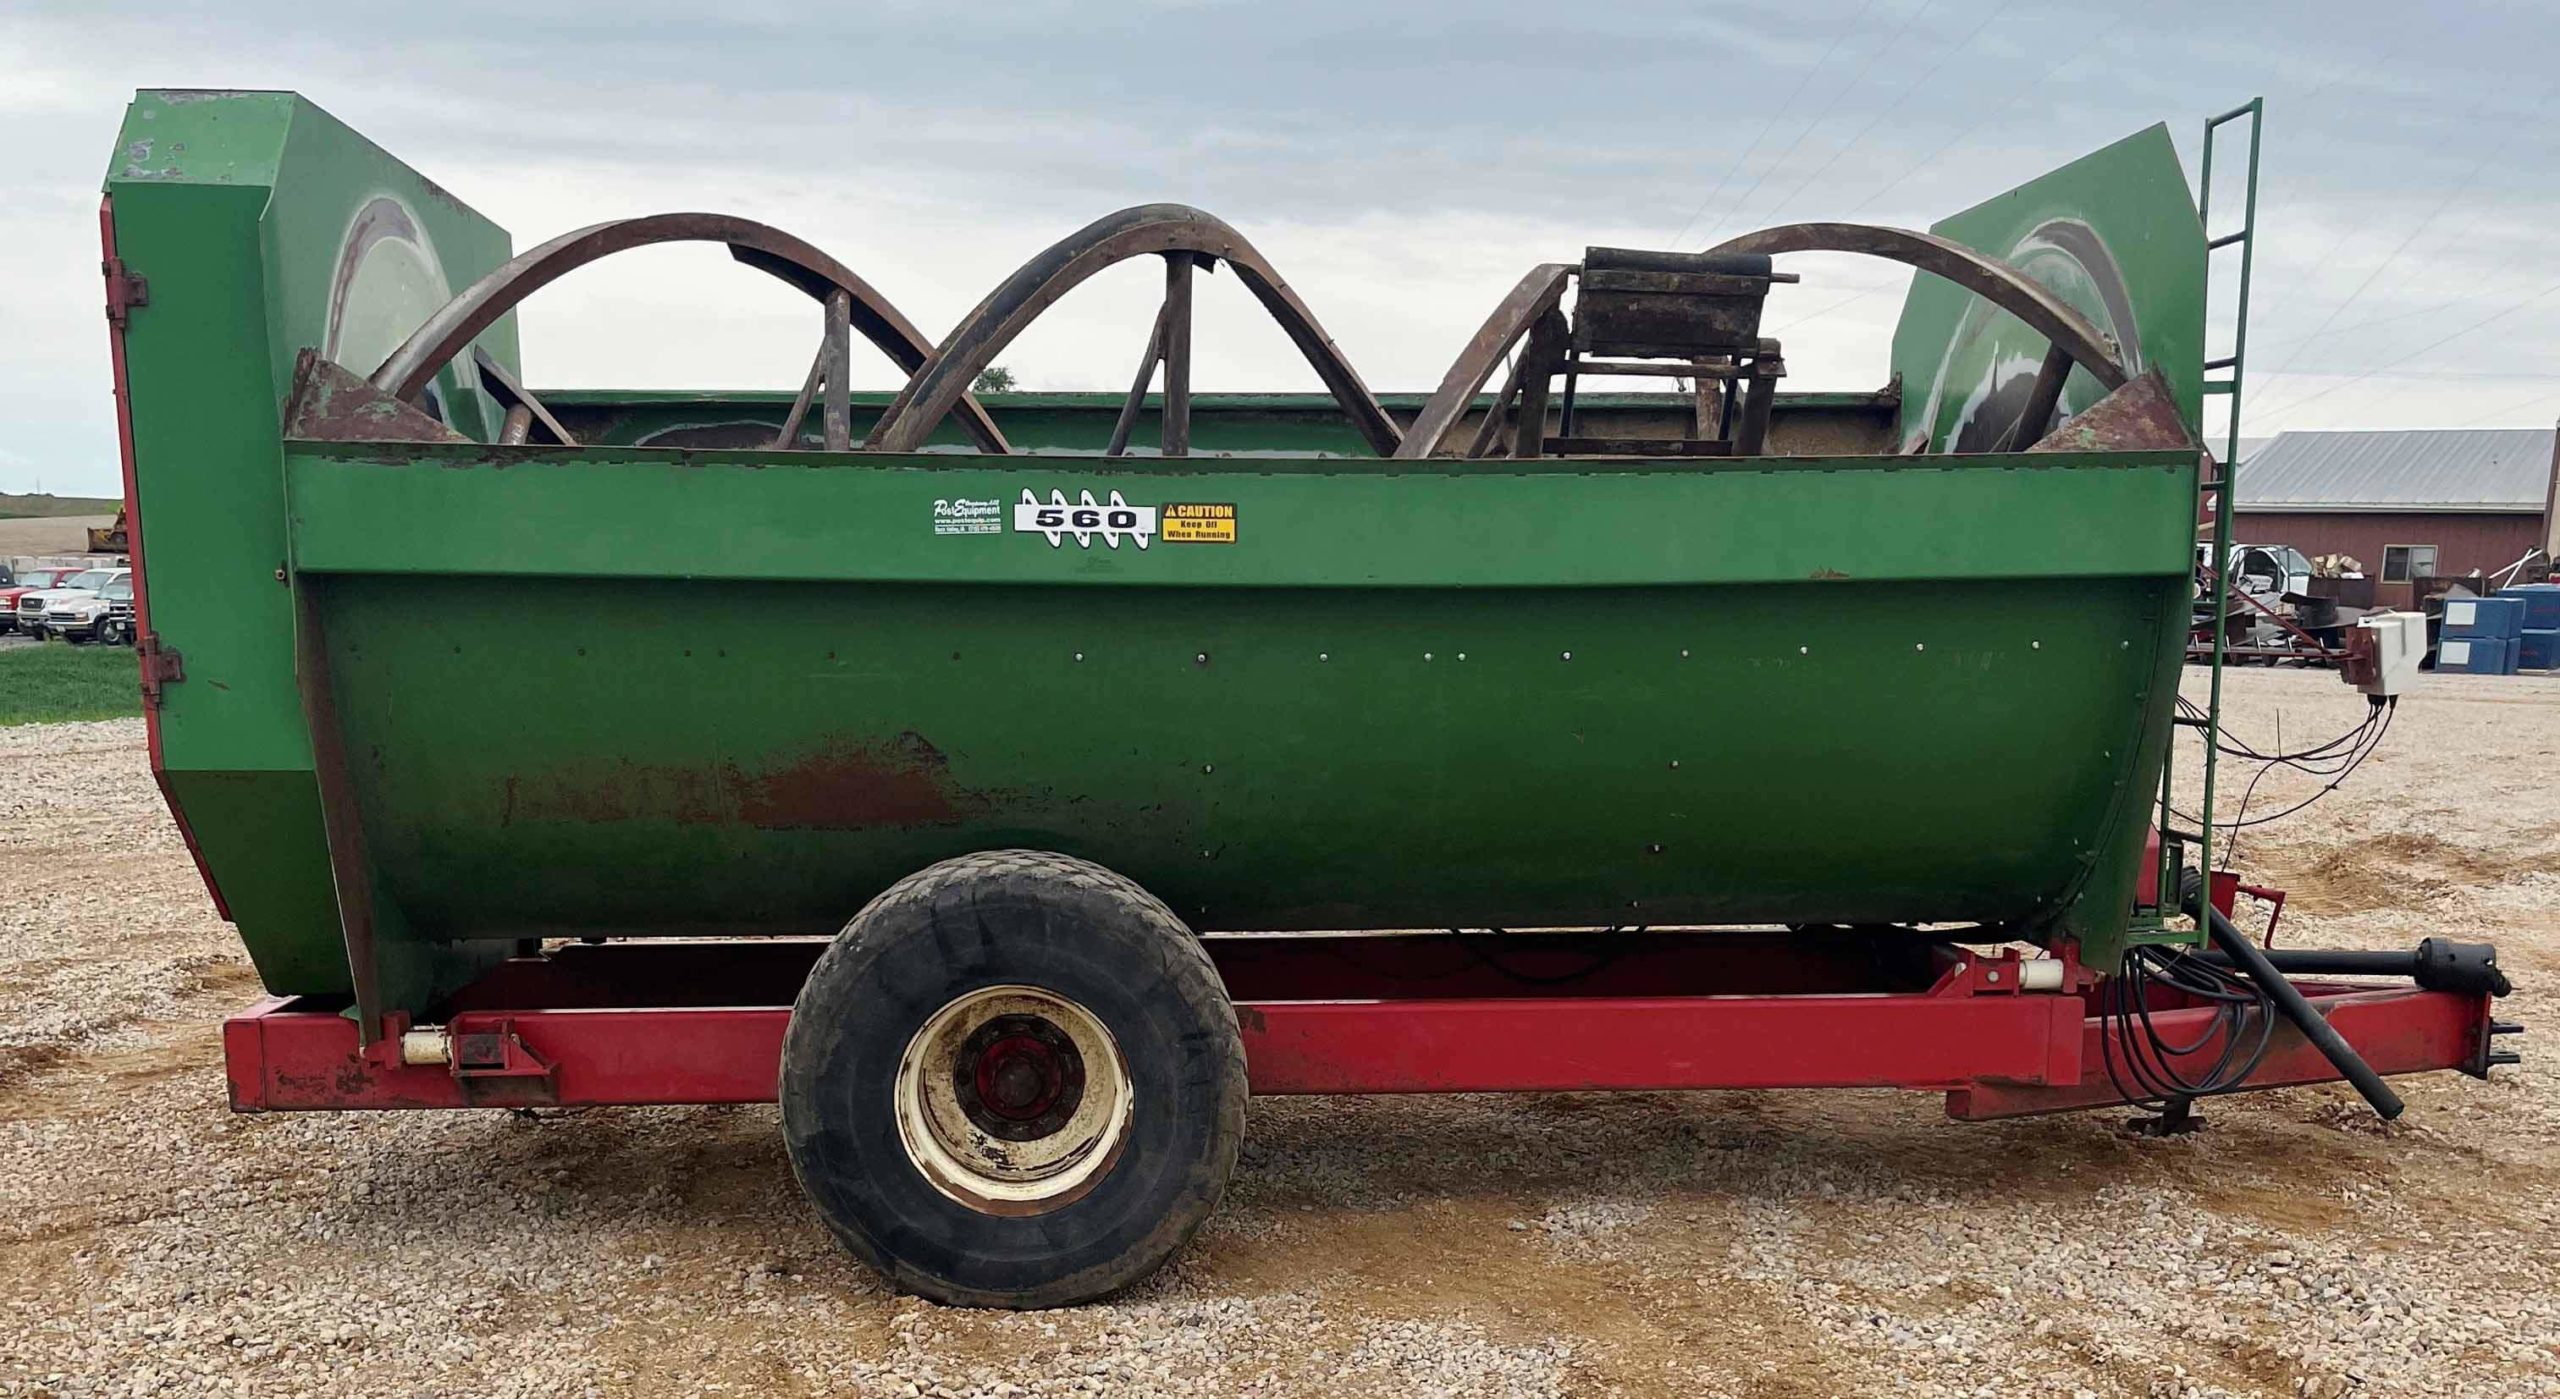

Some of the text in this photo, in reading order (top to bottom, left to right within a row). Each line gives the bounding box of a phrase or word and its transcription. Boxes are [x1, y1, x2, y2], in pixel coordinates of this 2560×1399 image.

[1177, 504, 1234, 518] CAUTION
[1035, 508, 1137, 529] 560
[1180, 520, 1218, 529] Keep Off
[1167, 530, 1231, 540] When Running
